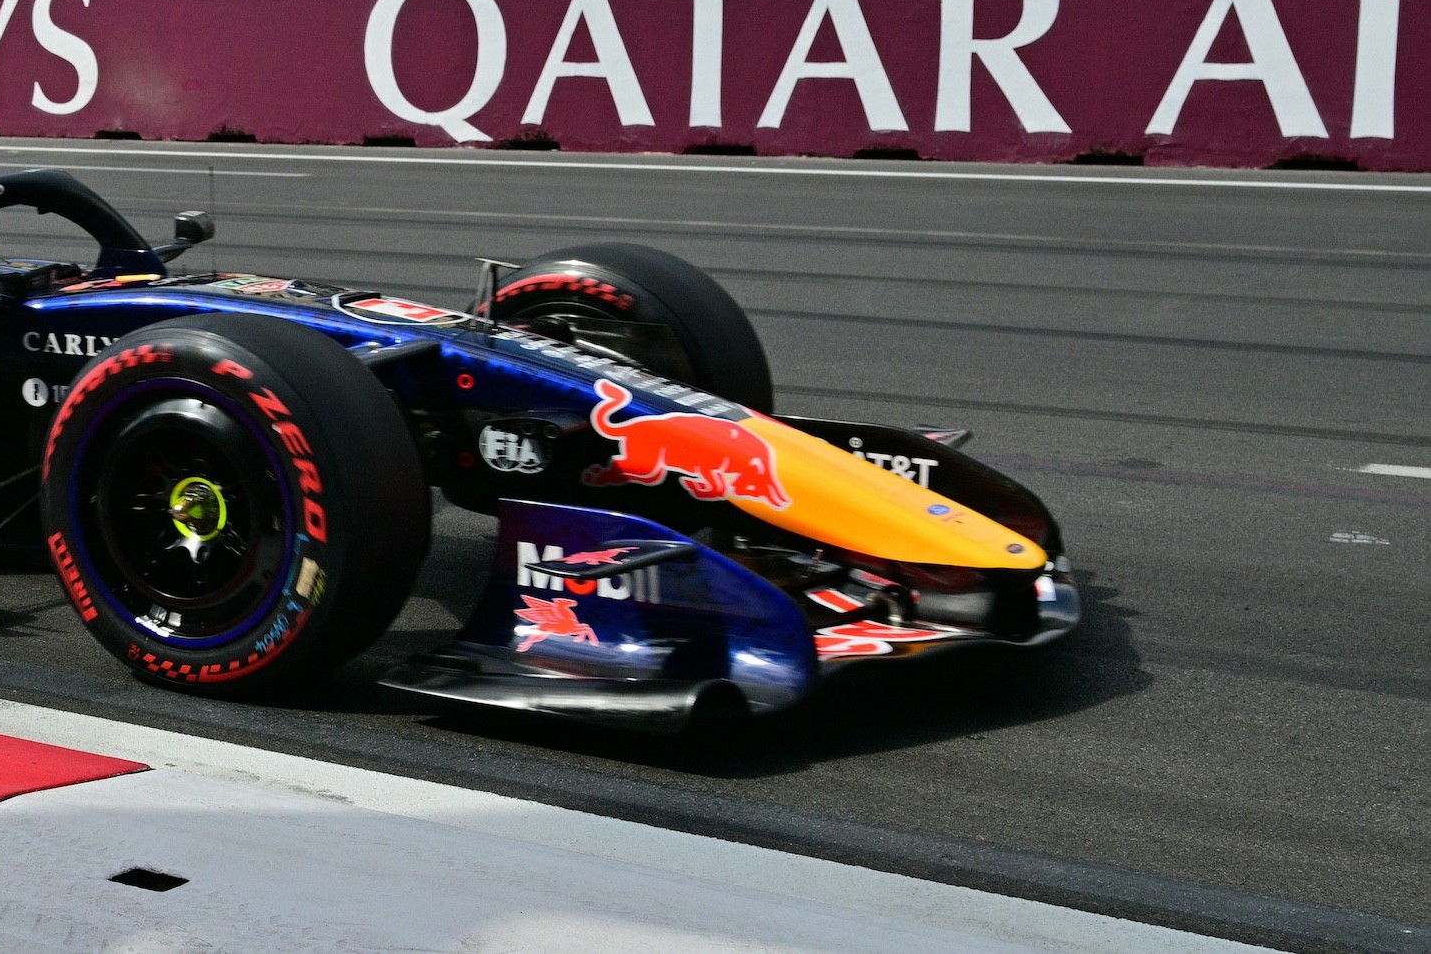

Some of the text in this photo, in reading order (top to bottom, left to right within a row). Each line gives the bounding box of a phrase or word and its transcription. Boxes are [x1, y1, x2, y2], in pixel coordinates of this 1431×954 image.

[210, 358, 254, 380] P
[248, 386, 328, 544] ZERO
[853, 451, 939, 489] T&T
